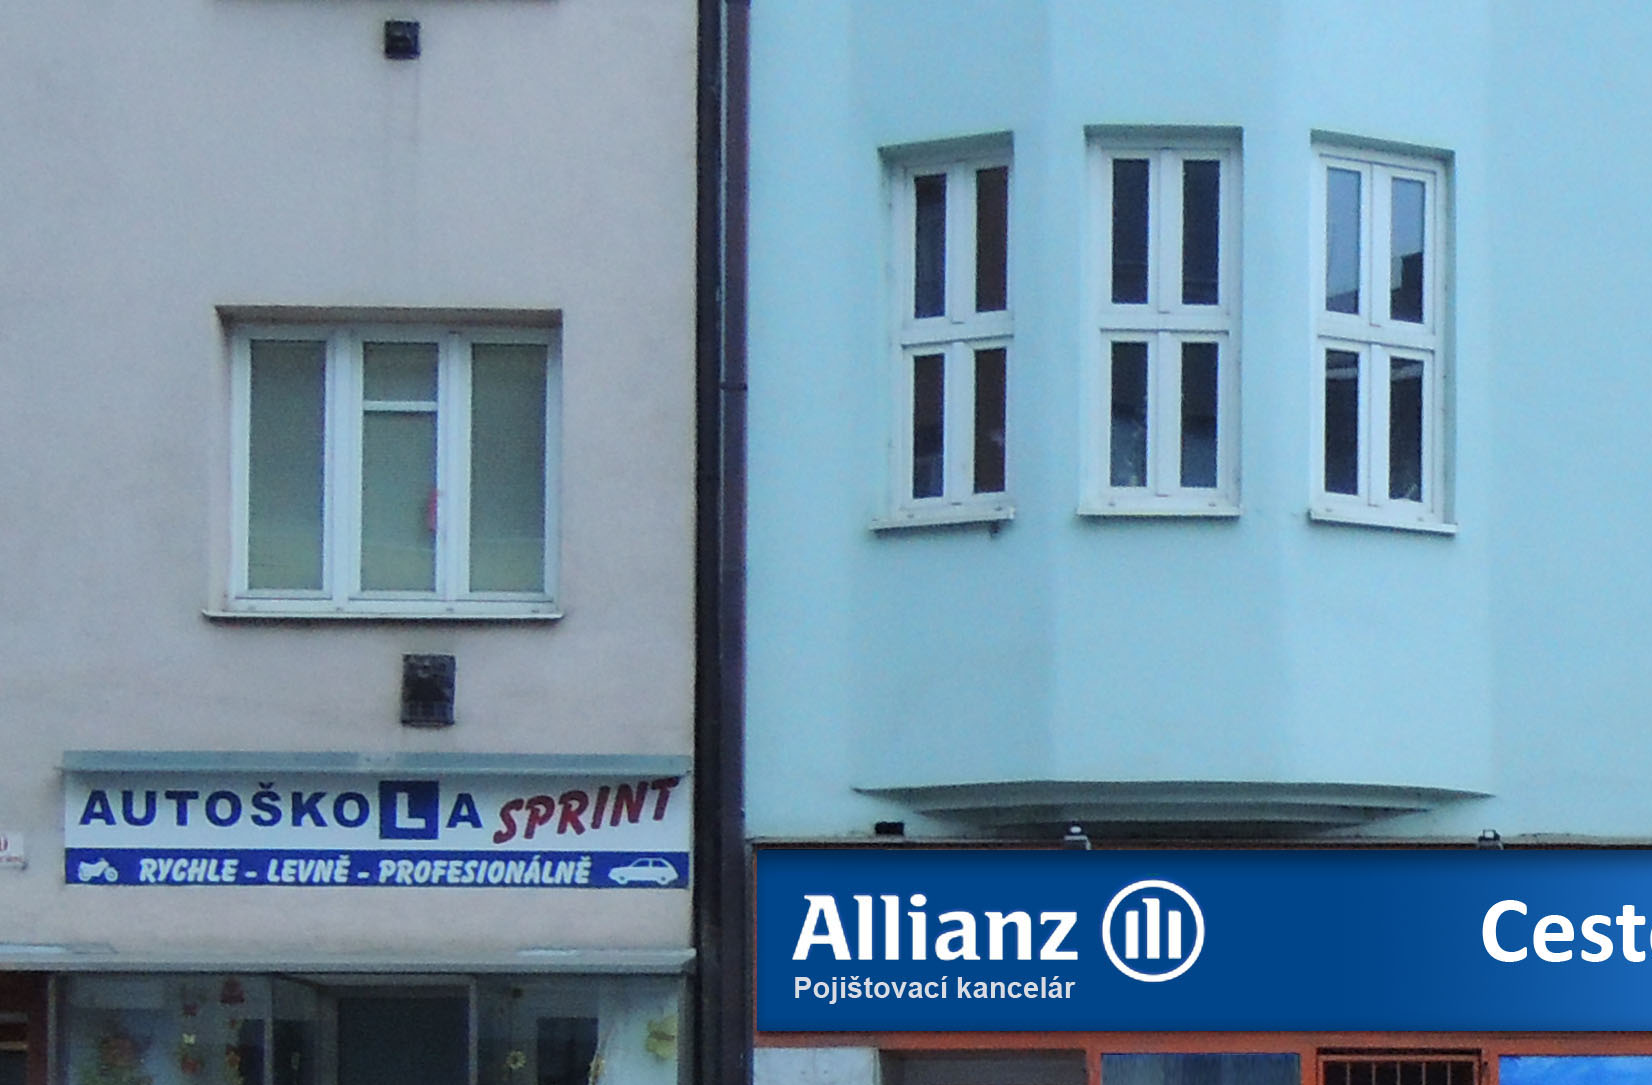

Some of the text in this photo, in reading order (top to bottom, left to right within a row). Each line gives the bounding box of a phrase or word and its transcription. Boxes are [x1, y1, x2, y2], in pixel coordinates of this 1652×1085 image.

[79, 776, 681, 844] AUTOŠKOLA SPRINT
[139, 857, 239, 884] RYCHLE
[266, 854, 351, 884] LEVNĚ
[378, 854, 592, 885] PROFESIONÁLNĚ
[791, 893, 1079, 961] Allianz
